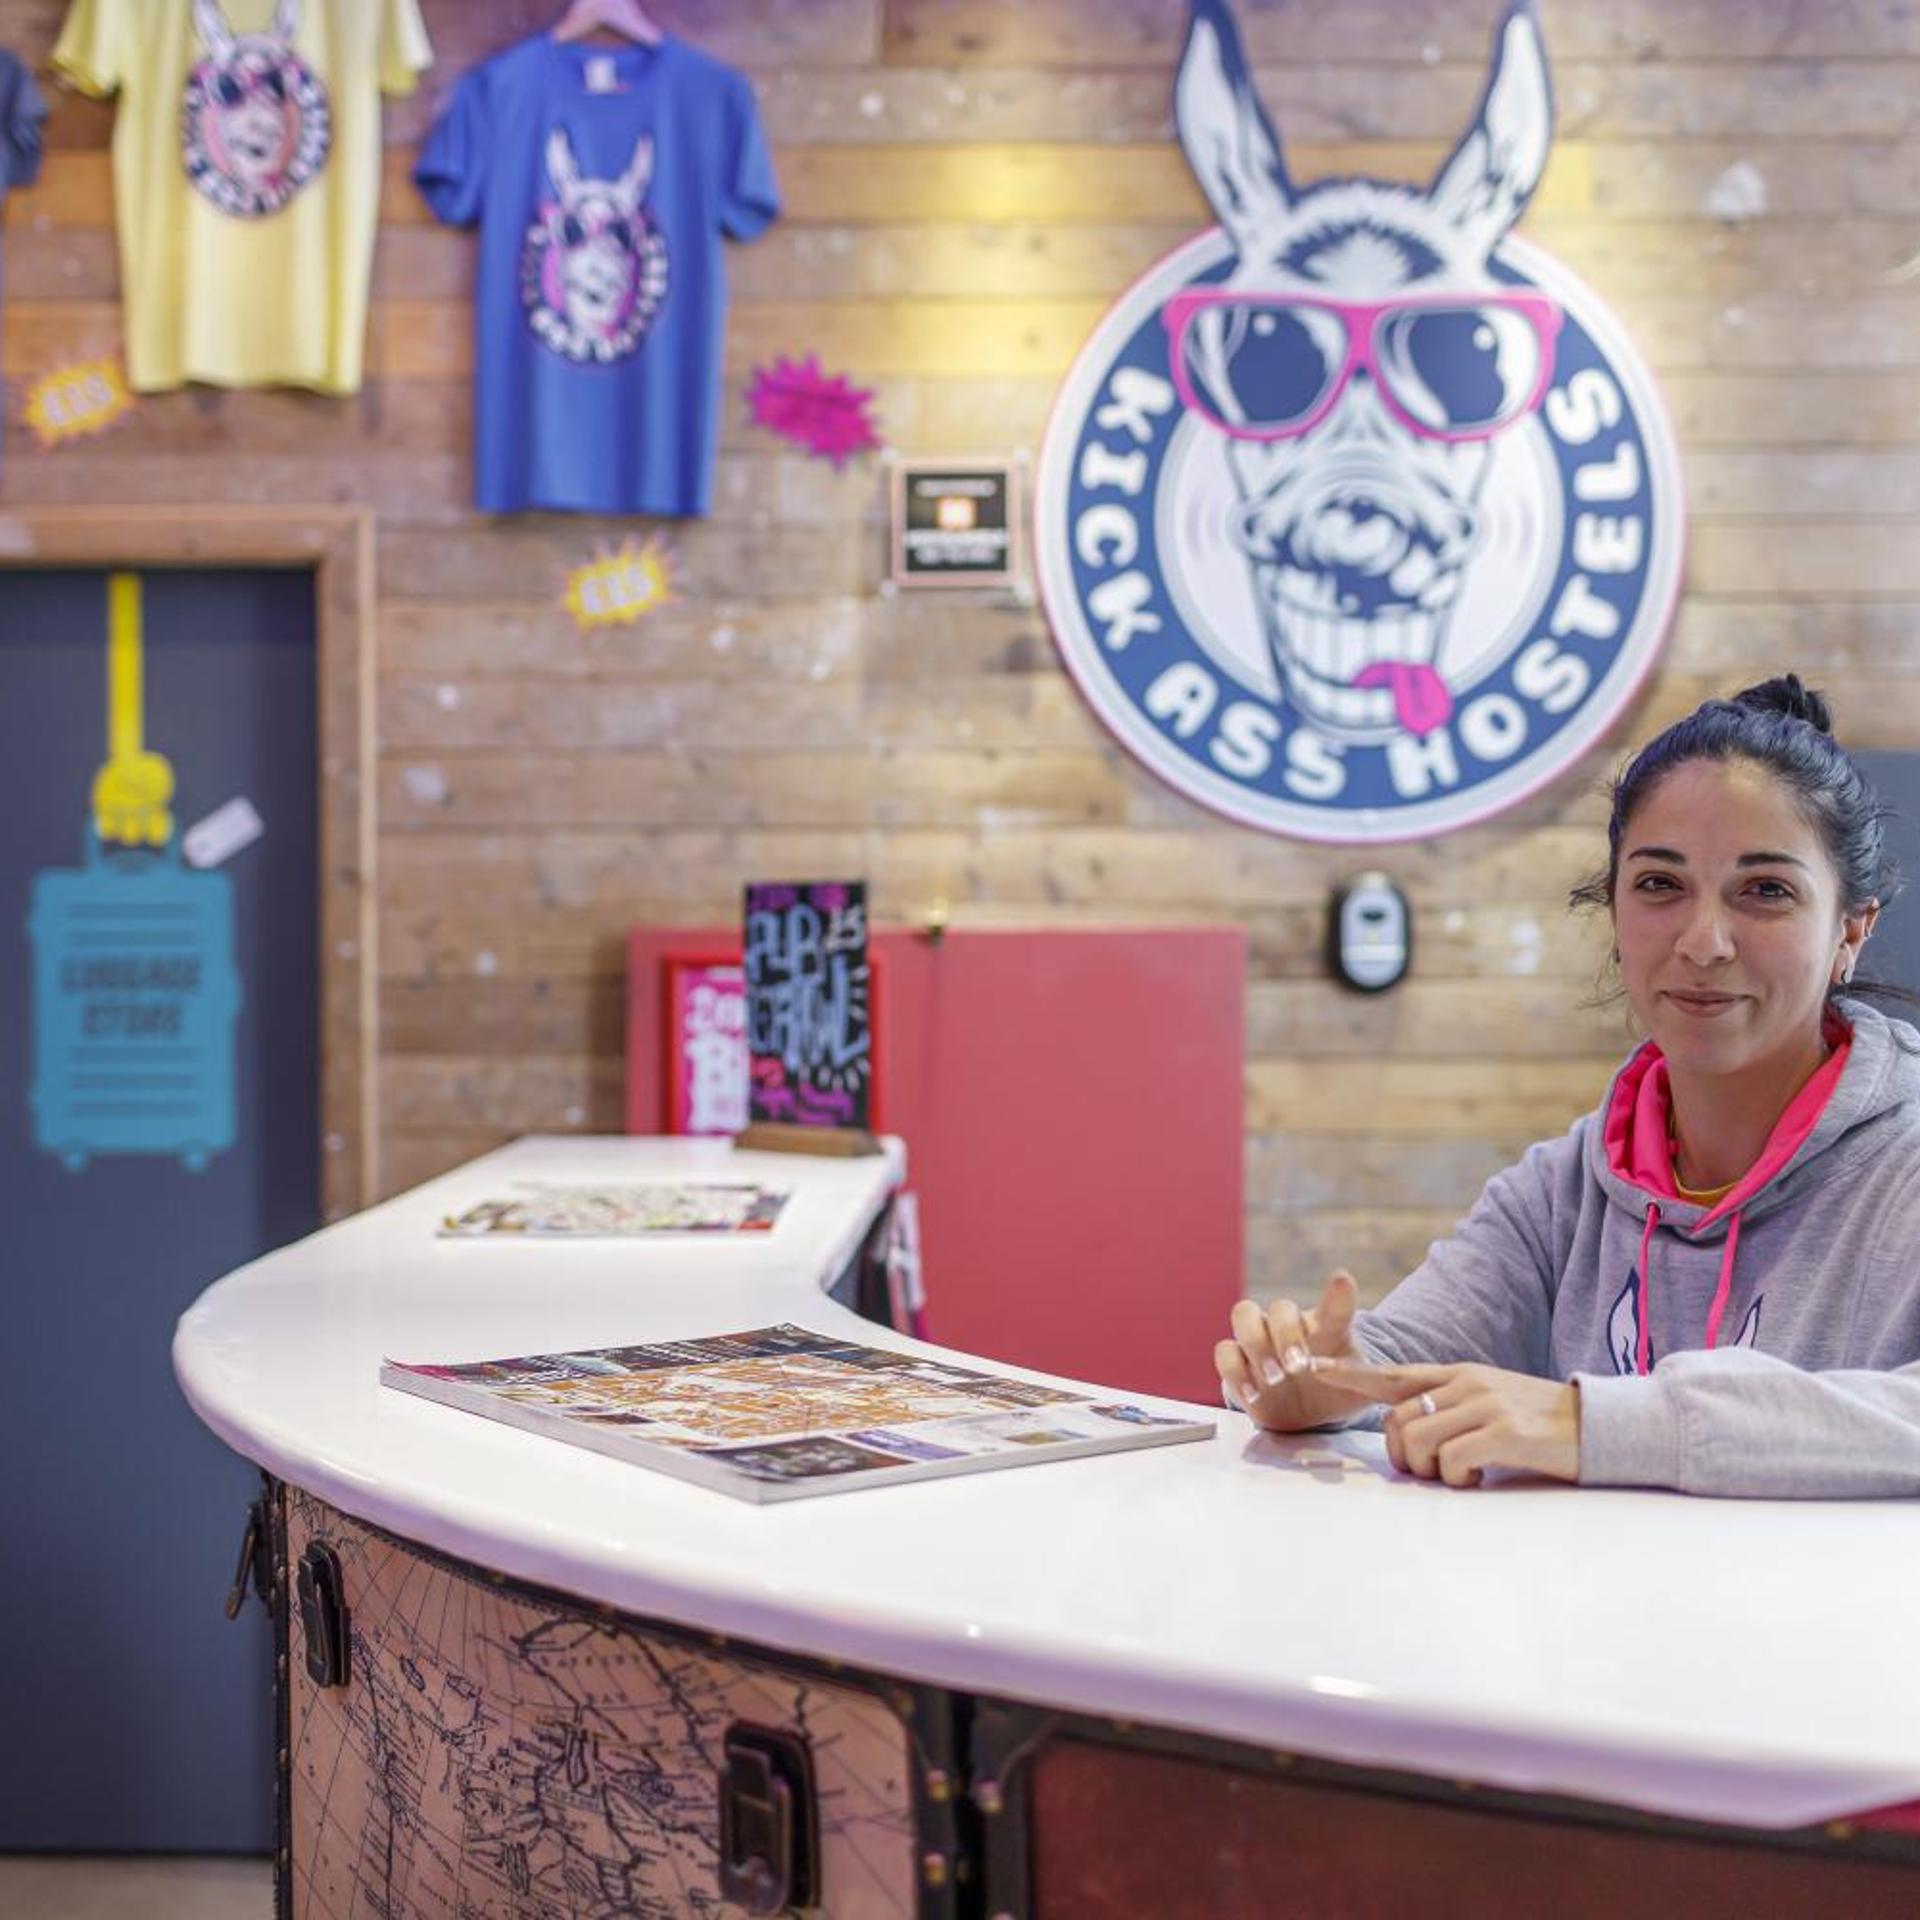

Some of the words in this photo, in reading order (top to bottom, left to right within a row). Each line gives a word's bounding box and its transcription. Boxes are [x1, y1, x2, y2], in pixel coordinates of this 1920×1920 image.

[1075, 366, 1174, 651] KICK
[1145, 661, 1347, 800] ASS
[1387, 368, 1643, 799] HOSTELS
